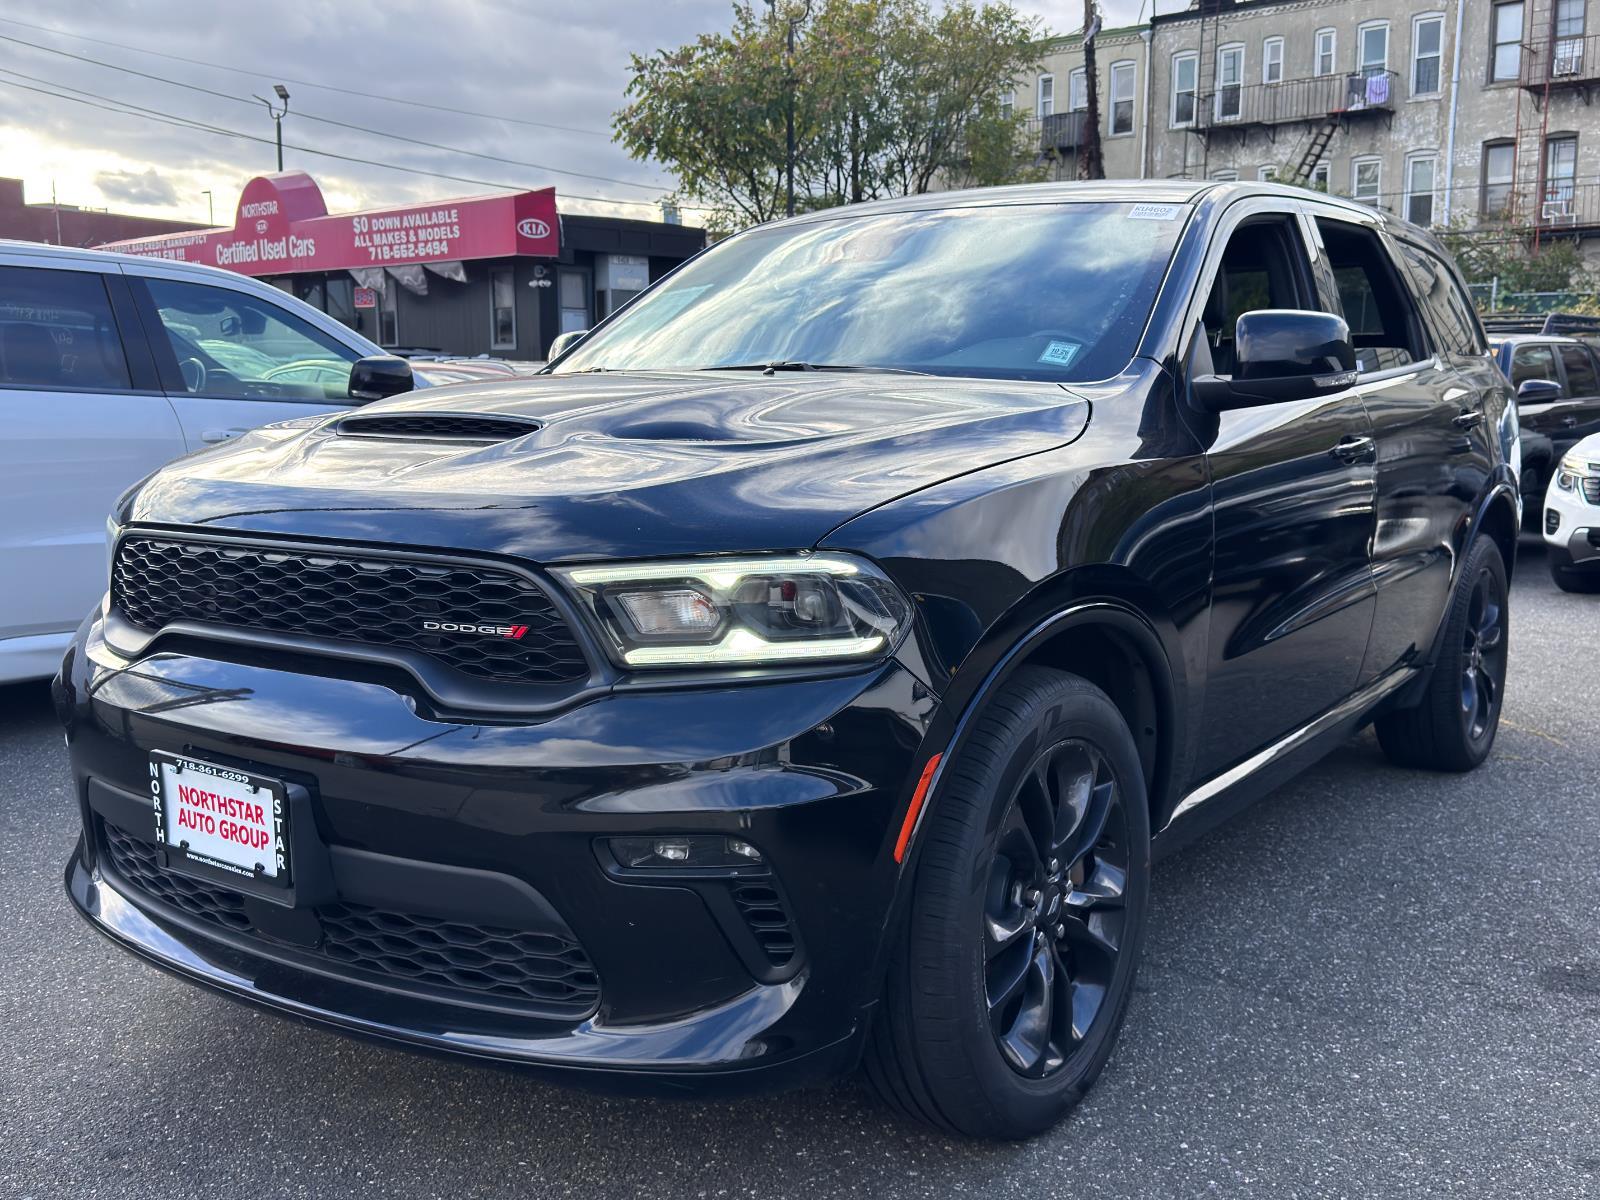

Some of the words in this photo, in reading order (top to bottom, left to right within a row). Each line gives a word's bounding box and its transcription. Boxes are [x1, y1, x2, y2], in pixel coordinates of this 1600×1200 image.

[242, 201, 278, 218] NORTHSTAR
[372, 217, 400, 231] DOWN
[403, 209, 458, 229] AVAILABLE
[354, 235, 372, 248] ALL
[373, 231, 407, 246] MAKES
[409, 230, 416, 242] &
[418, 225, 460, 241] MODELS
[523, 223, 546, 235] KIA
[166, 235, 208, 249] BANKRUPTCY
[216, 240, 258, 265] Certified
[260, 237, 287, 260] Used
[289, 235, 315, 258] Cars
[423, 621, 513, 635] DODGE
[176, 759, 249, 784] 718-361-6299
[150, 762, 164, 843] NORTH
[178, 784, 265, 826] NORTHSTAR
[178, 808, 215, 835] AUTO
[219, 820, 269, 850] GROUP
[274, 799, 285, 870] STAR
